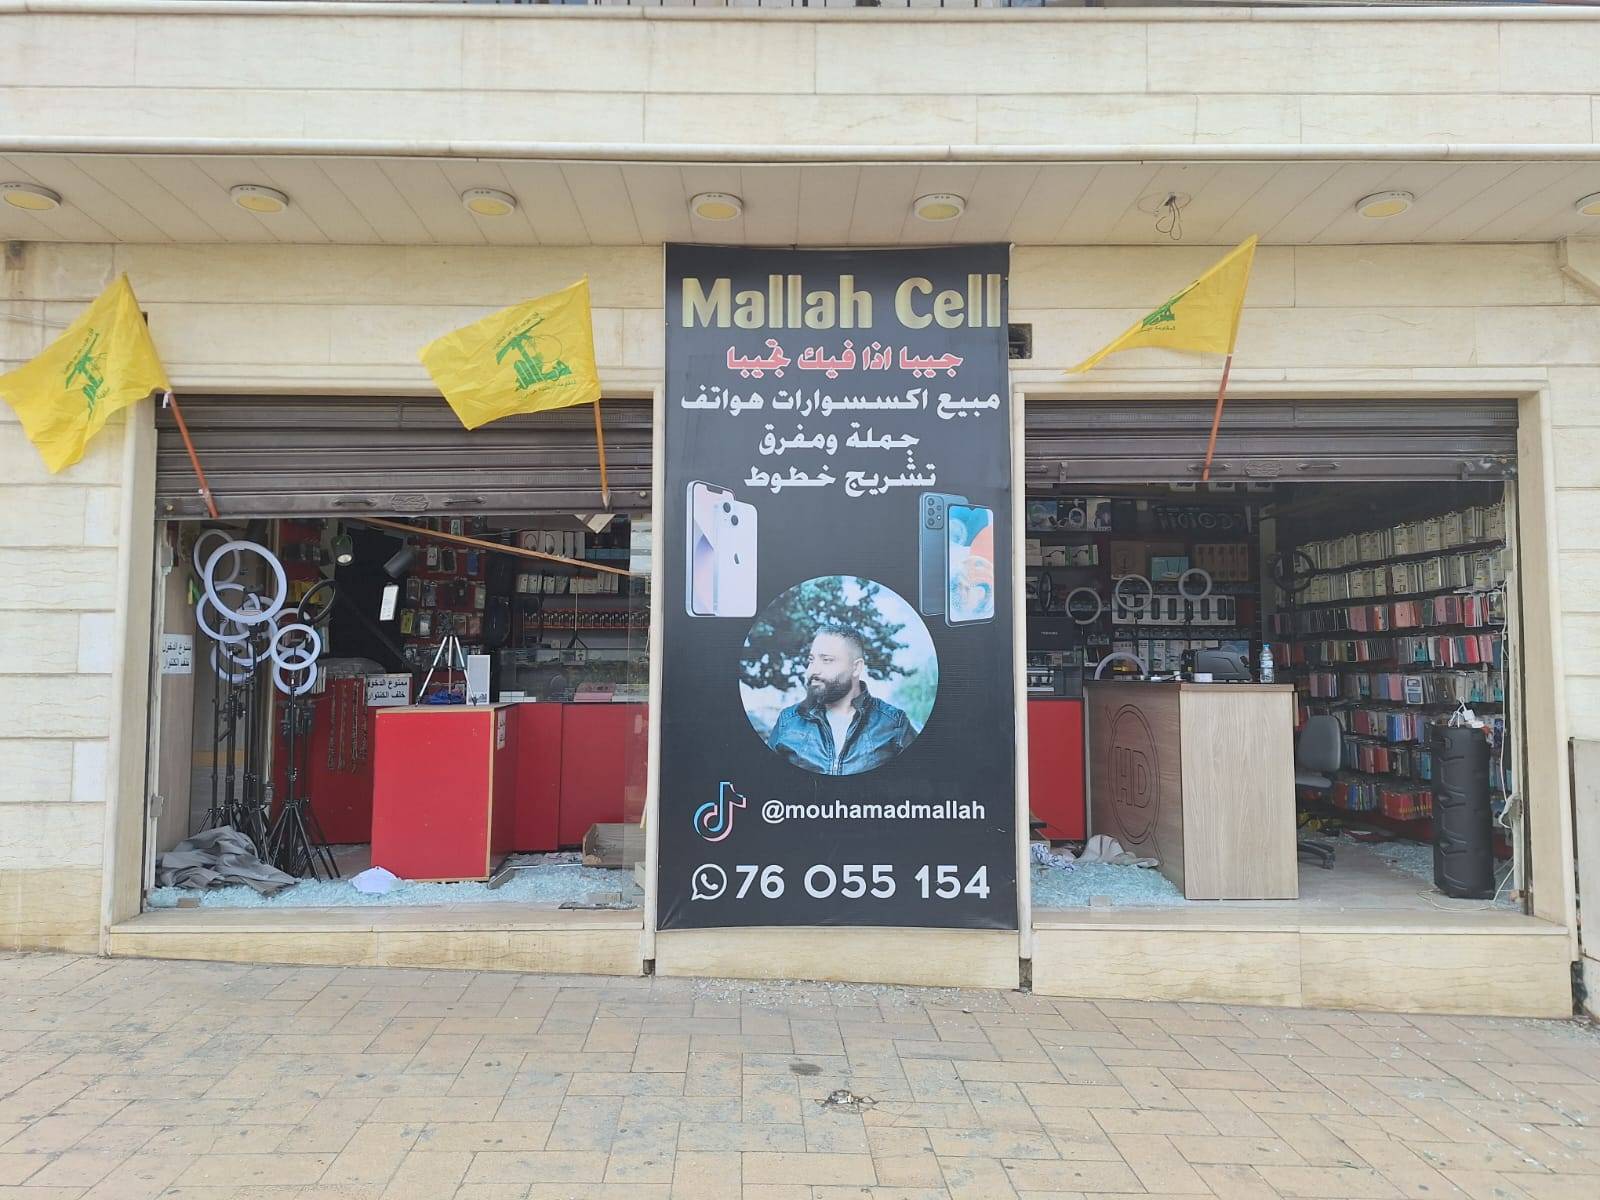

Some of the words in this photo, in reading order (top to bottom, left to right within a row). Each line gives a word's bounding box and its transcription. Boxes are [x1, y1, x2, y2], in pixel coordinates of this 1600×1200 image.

[681, 274, 873, 329] Mallah
[895, 273, 1002, 329] Cell
[726, 338, 791, 378] تجيبا
[797, 339, 856, 379] فيك
[862, 341, 892, 371] اذا
[899, 345, 964, 378] جيبا
[680, 384, 765, 416] هواتف
[772, 388, 928, 417] اكسسوارات
[936, 393, 1000, 420] مبيع
[758, 423, 838, 456] ومفرق
[846, 421, 920, 456] جملة
[743, 464, 836, 494] خطوط
[845, 457, 936, 497] تشريج
[761, 799, 985, 824] @mouhamadmallah
[735, 864, 785, 899] 76
[804, 864, 896, 899] 055
[914, 864, 990, 899] 154
